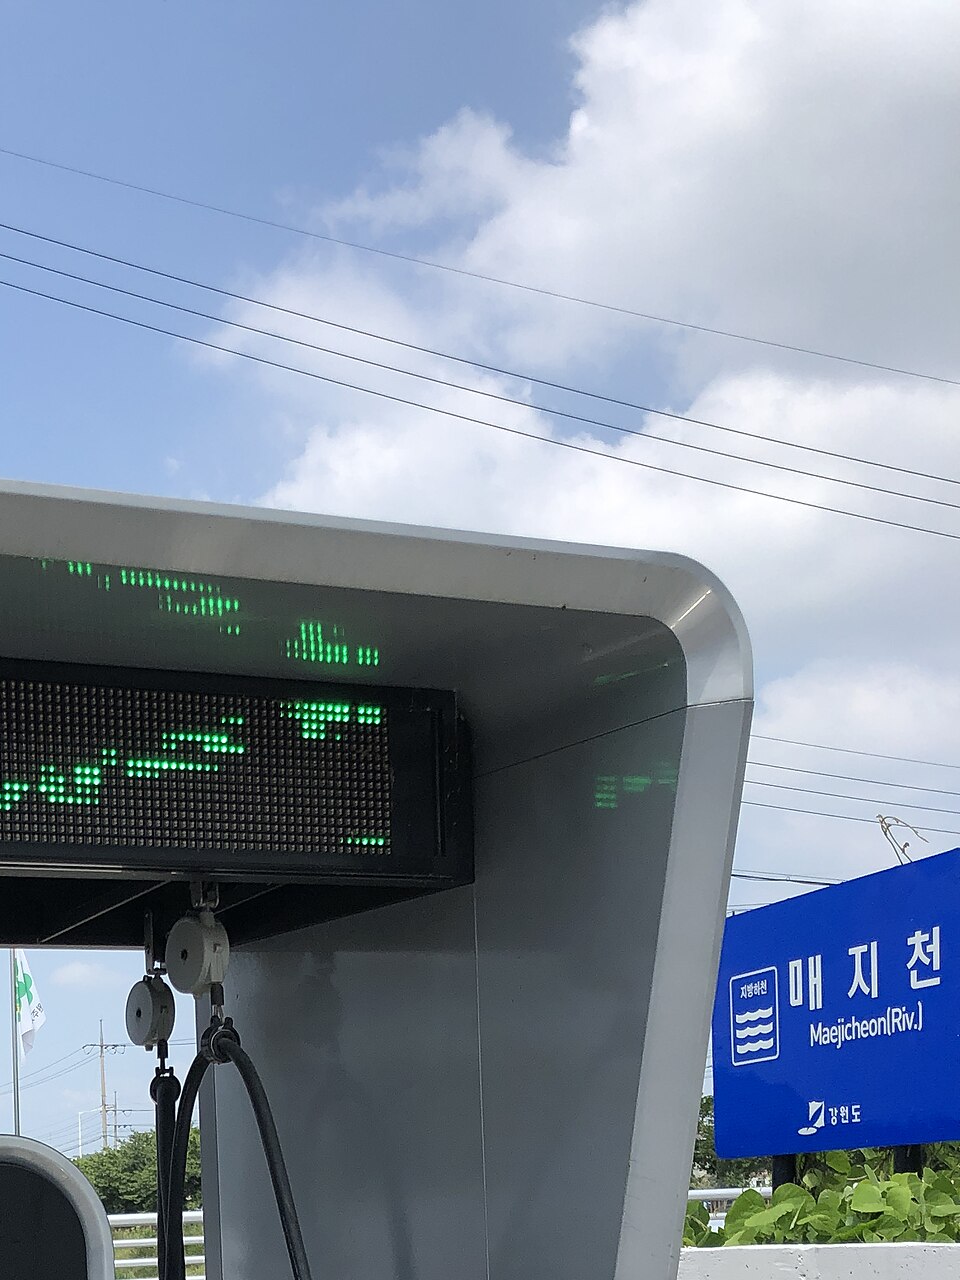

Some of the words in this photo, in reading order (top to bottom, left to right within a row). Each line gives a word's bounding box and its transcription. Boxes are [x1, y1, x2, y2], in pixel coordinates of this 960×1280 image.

[789, 925, 942, 1011] 매지천
[740, 979, 768, 999] 지방하천
[809, 1001, 923, 1049] Maejicheon(Riv.)
[828, 1104, 862, 1126] 강원도
